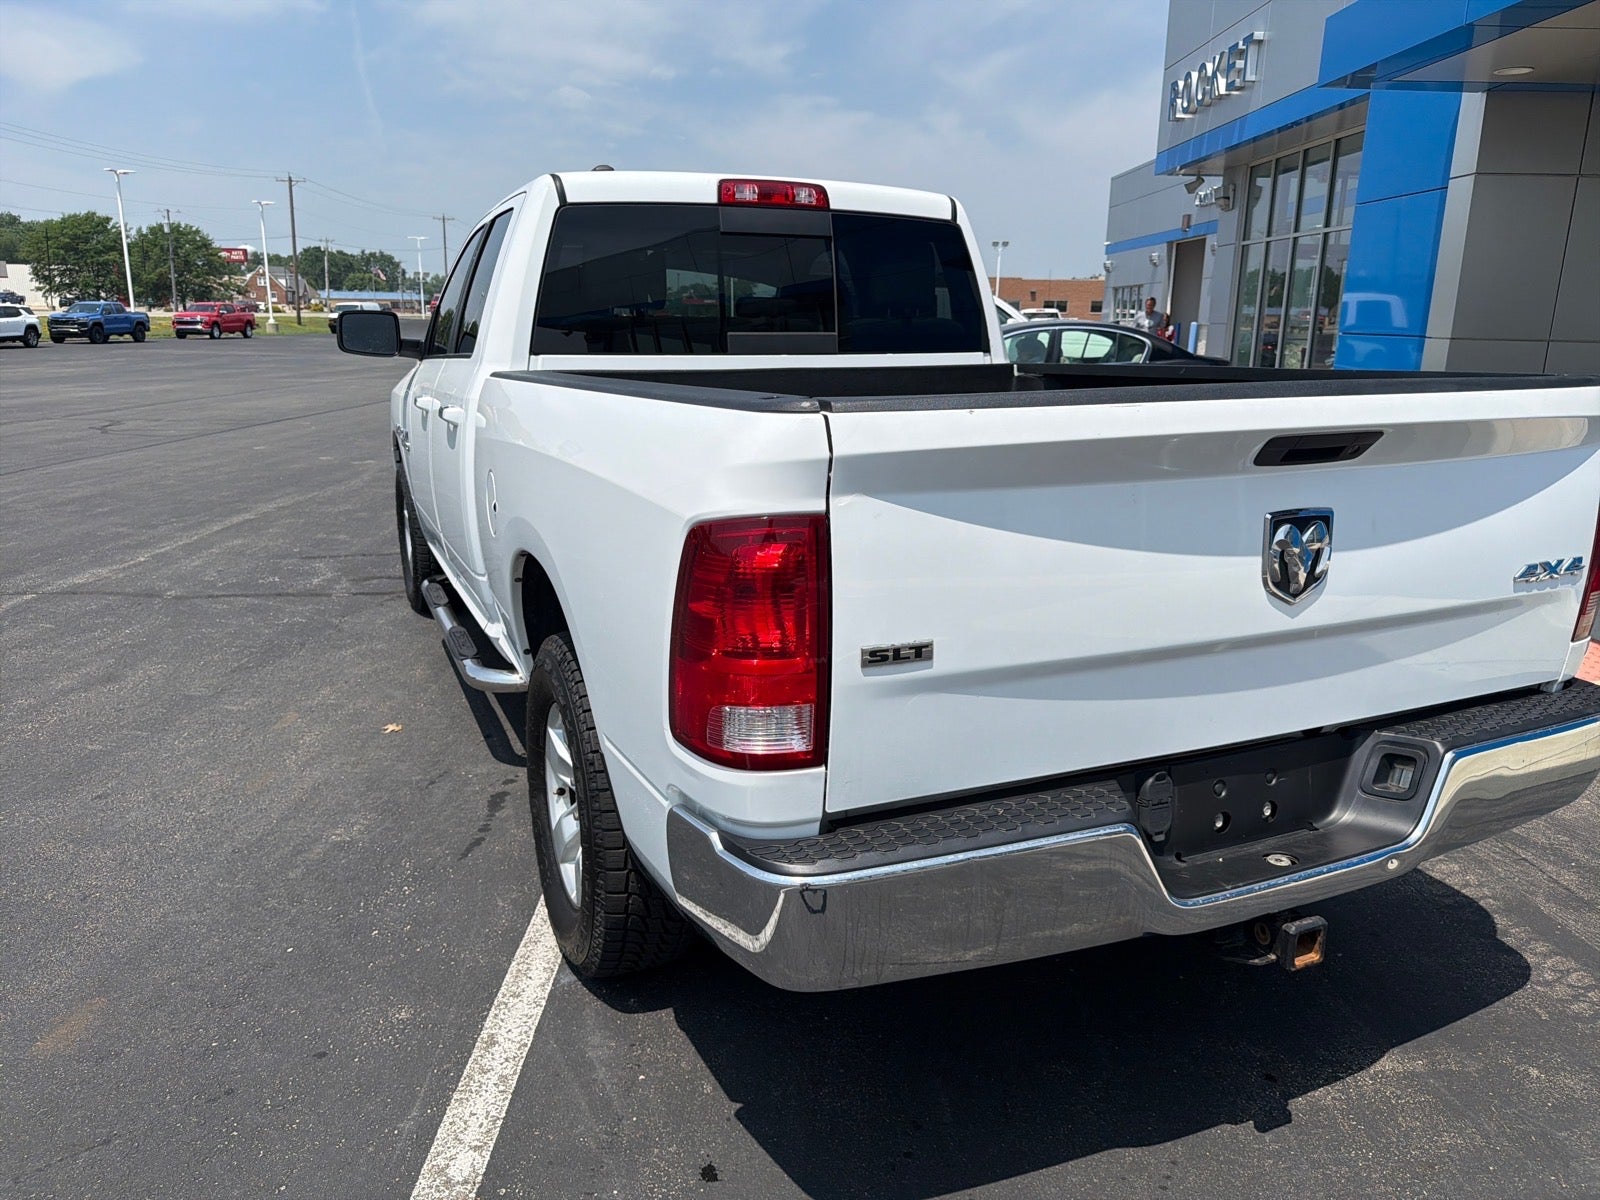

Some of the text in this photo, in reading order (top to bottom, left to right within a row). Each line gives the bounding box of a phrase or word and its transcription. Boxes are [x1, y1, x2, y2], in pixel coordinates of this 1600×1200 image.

[1168, 31, 1264, 122] ROCKET
[1512, 556, 1585, 583] 4X4
[867, 644, 930, 664] SLT
